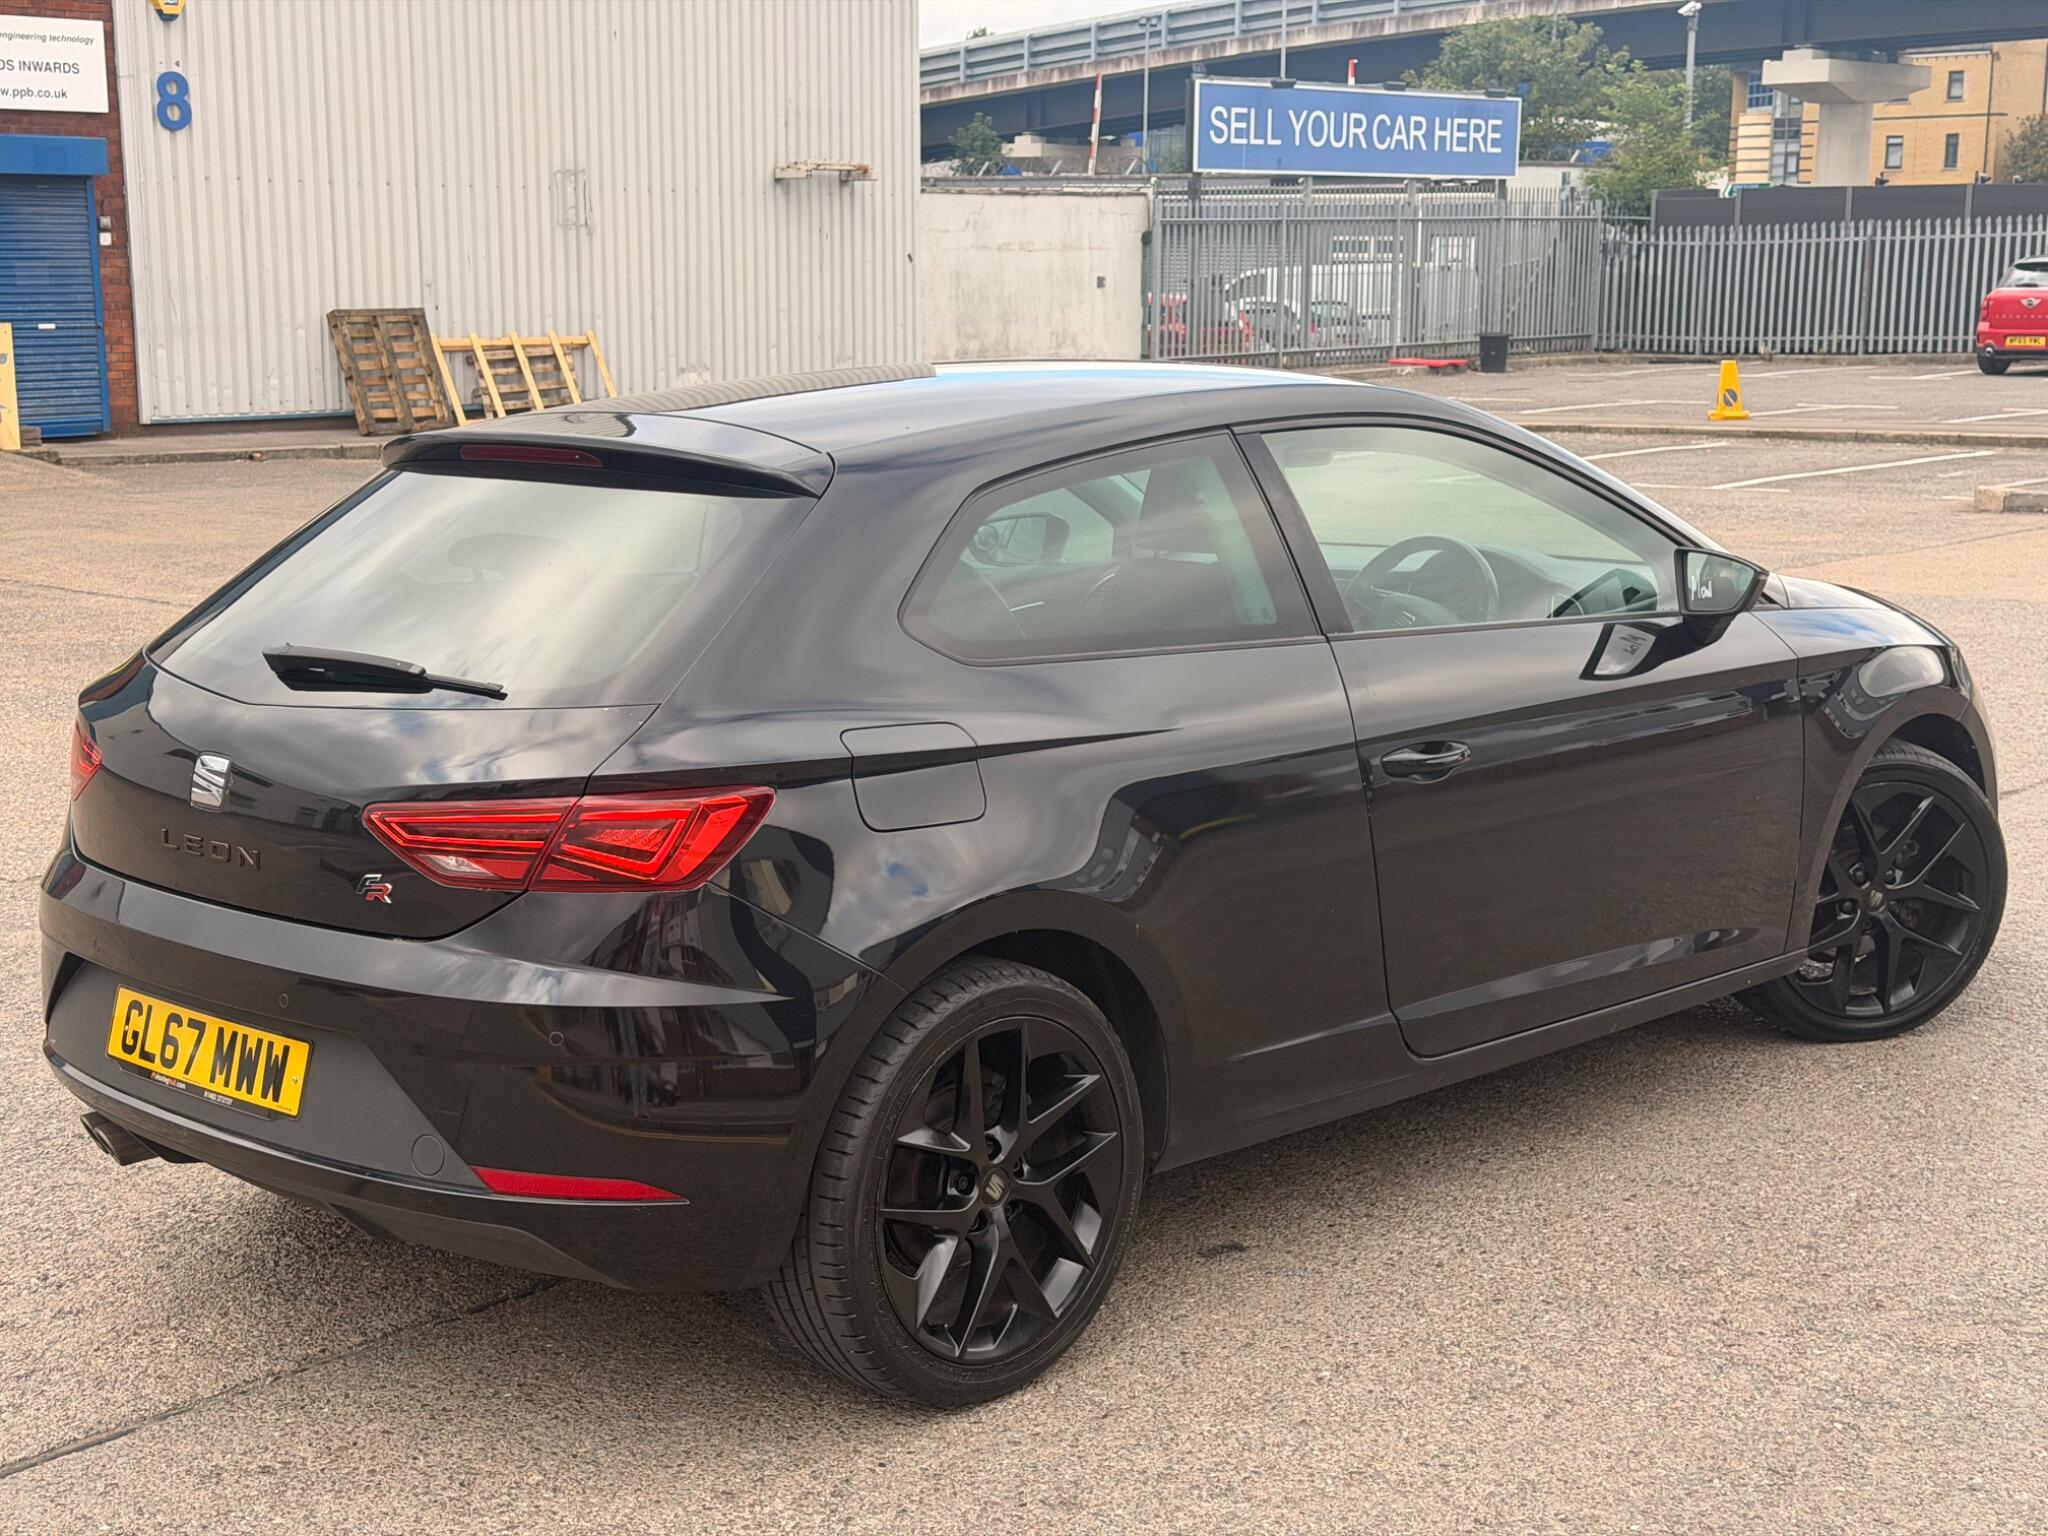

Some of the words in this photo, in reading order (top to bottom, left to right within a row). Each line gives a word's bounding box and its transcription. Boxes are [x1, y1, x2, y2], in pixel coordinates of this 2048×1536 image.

[49, 34, 95, 46] technology
[18, 60, 80, 75] INWARDS
[156, 71, 192, 132] 8
[1209, 105, 1282, 146] SELL
[1288, 109, 1367, 149] YOUR
[1372, 114, 1428, 151] CAR
[1433, 117, 1503, 153] HERE
[160, 828, 261, 871] LEON
[355, 873, 393, 905] FR
[121, 999, 208, 1076] GL67
[209, 1026, 290, 1104] MWW
